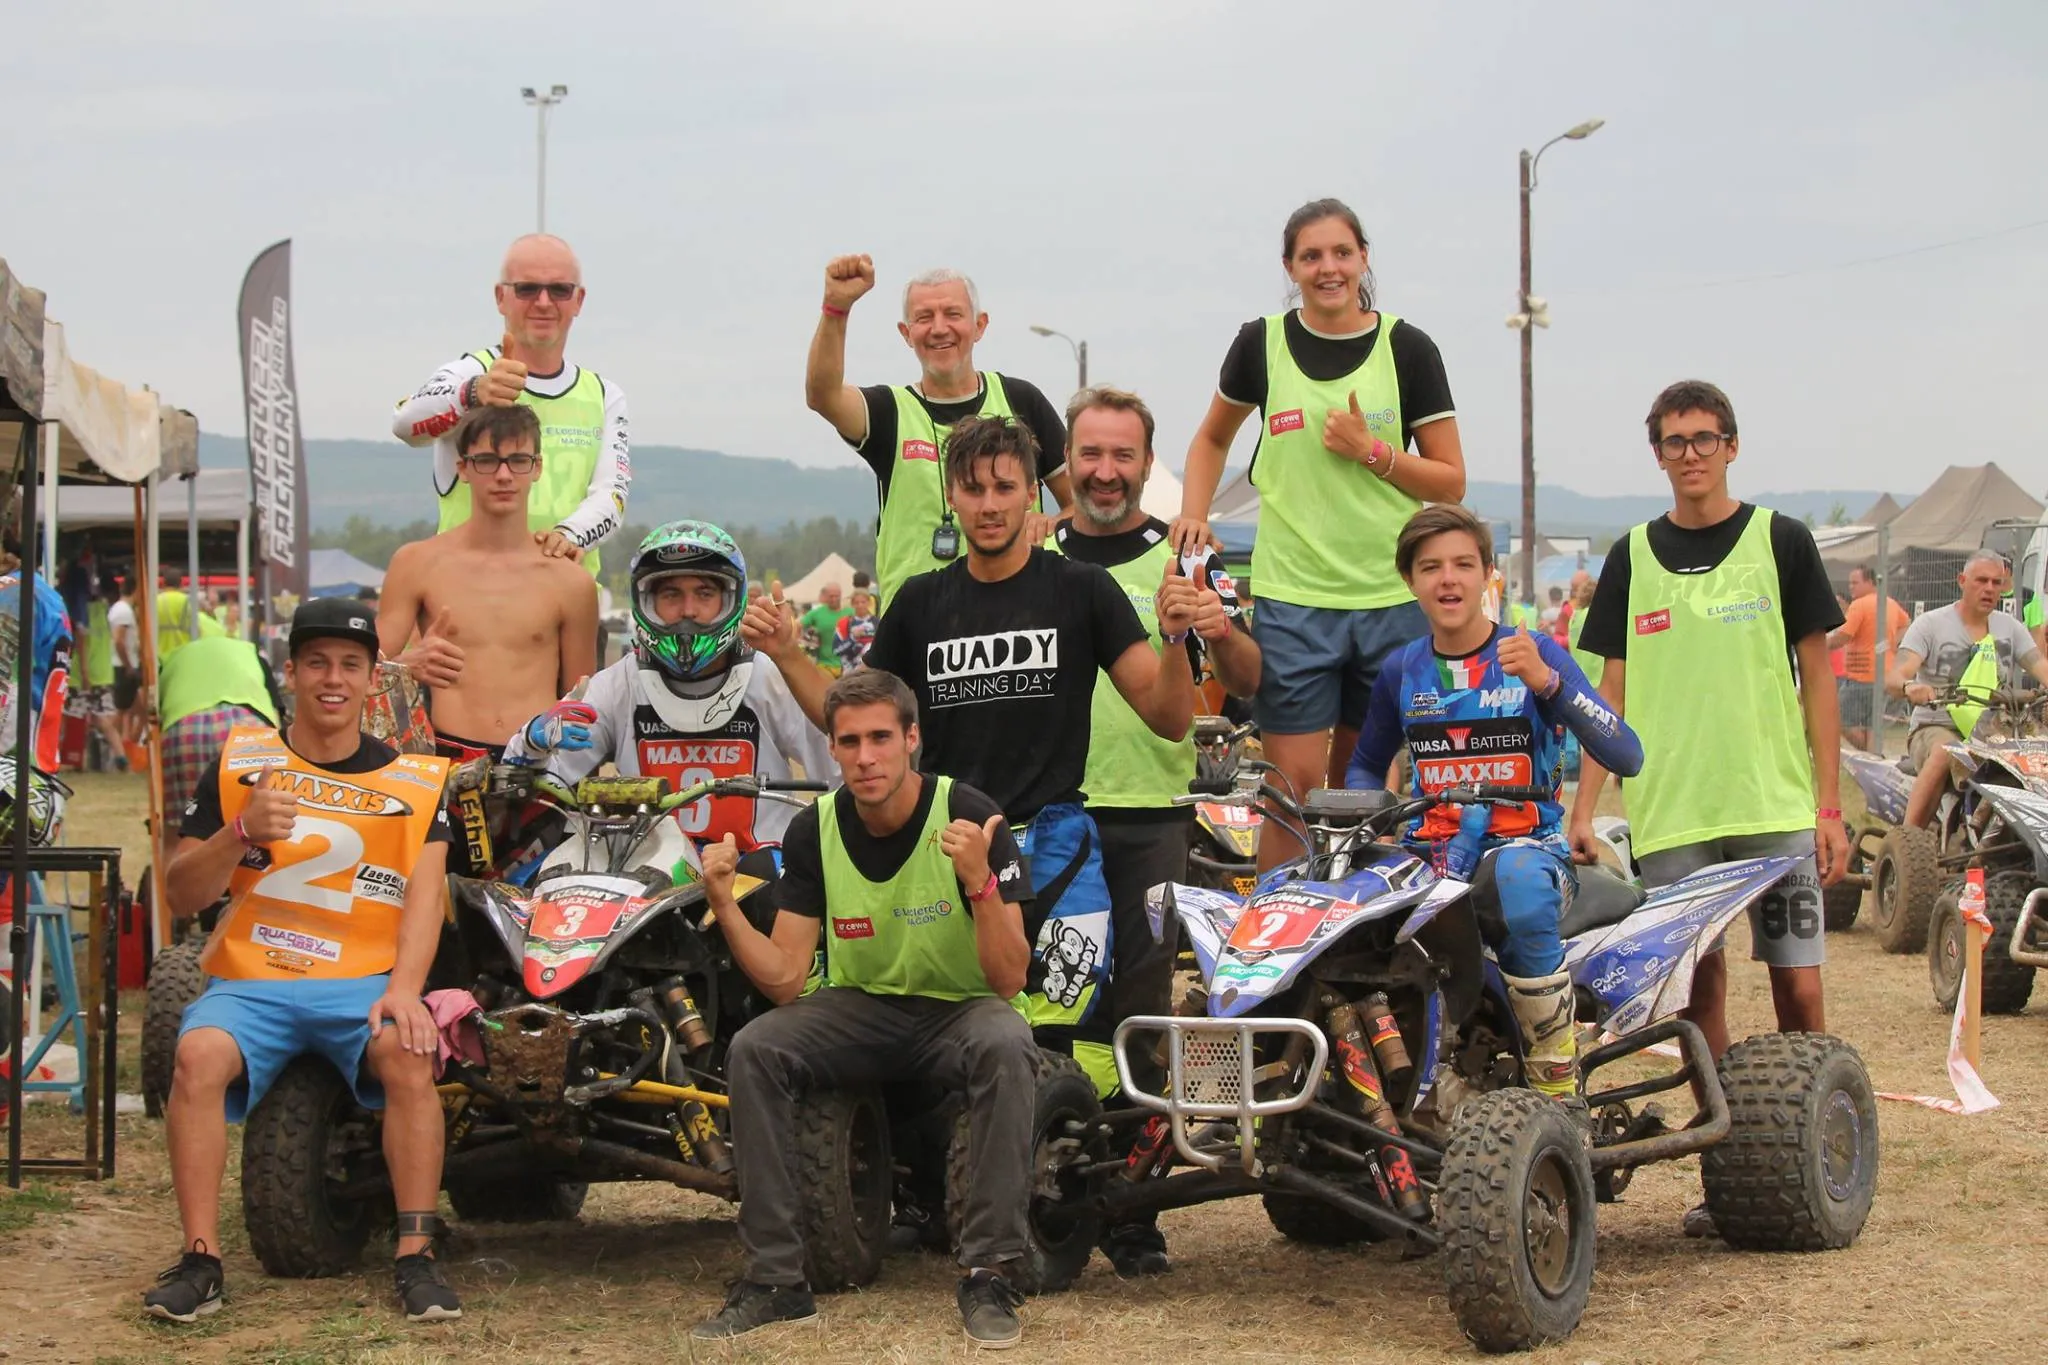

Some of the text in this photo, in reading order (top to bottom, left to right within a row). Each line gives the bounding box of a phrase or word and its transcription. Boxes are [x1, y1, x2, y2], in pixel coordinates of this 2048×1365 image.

[270, 381, 294, 567] FACTORY
[928, 633, 1055, 676] QUADDY
[928, 672, 1056, 702] TRAINING DAY
[646, 744, 741, 765] MAXXIS
[1410, 733, 1530, 752] YUASA BATTERY
[1423, 761, 1516, 785] MAXXIS
[271, 771, 388, 814] MAXXIS
[252, 817, 365, 914] 2
[553, 904, 589, 936] 3
[1248, 912, 1288, 947] 2
[1062, 936, 1098, 1008] QUADDY
[1592, 966, 1626, 989] QUAD
[1598, 974, 1630, 996] MANIA
